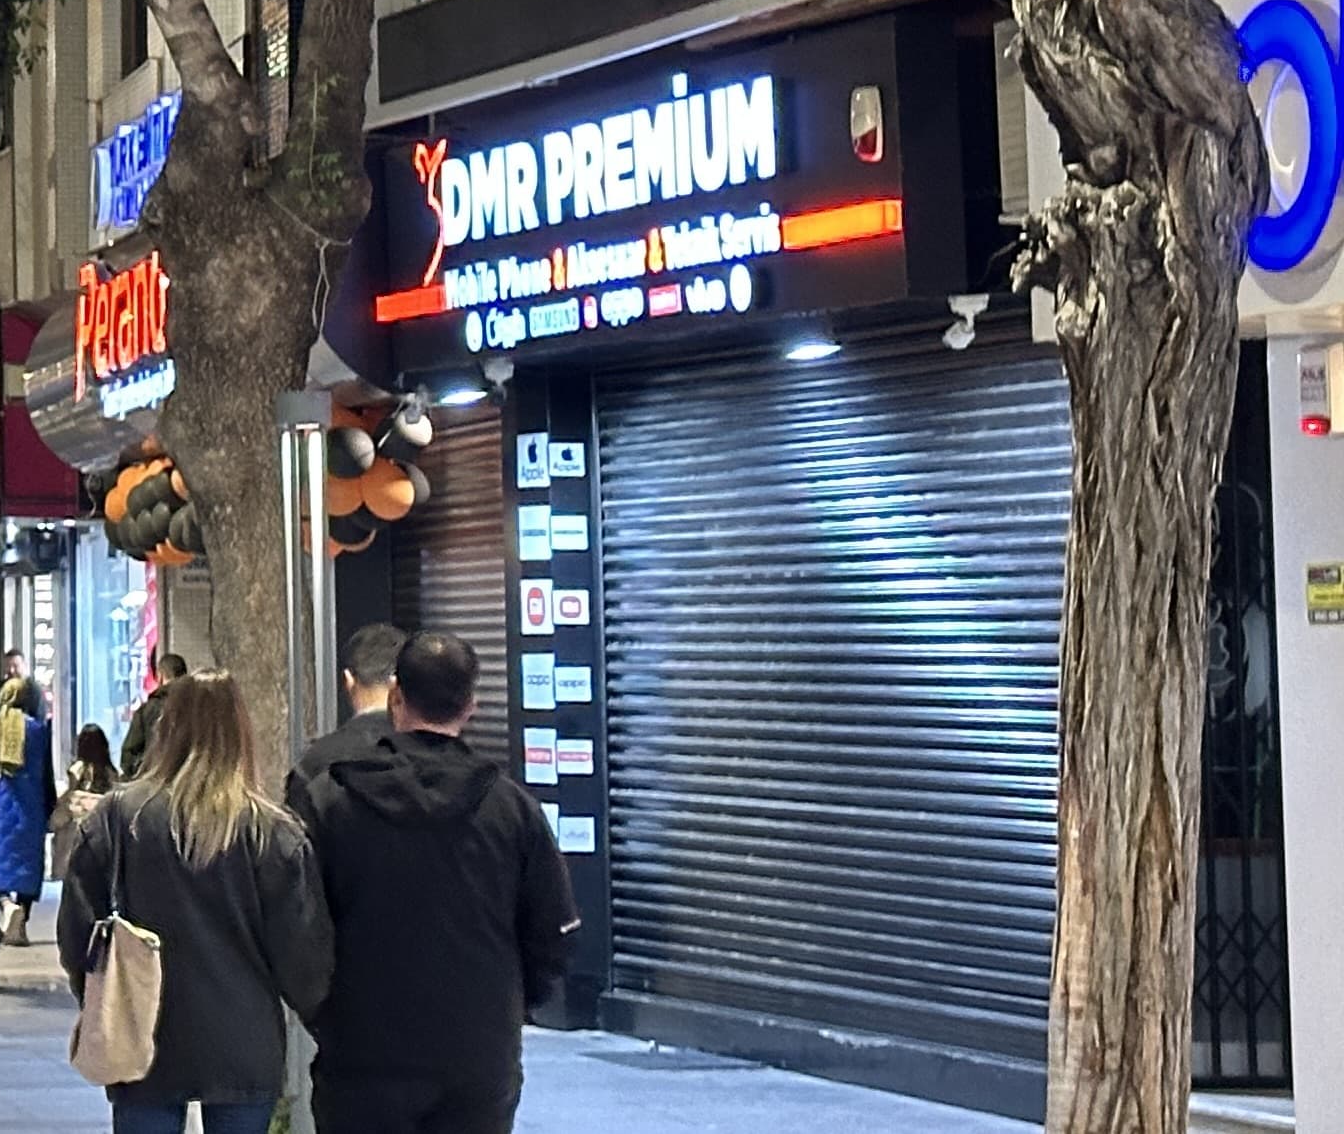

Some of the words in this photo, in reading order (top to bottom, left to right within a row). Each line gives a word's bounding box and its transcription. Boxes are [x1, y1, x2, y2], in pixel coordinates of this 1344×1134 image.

[442, 140, 538, 246] DMR
[543, 72, 777, 225] PREMİUM
[444, 262, 498, 311] Mobile
[497, 254, 552, 301] Phone
[719, 201, 781, 259] Servis
